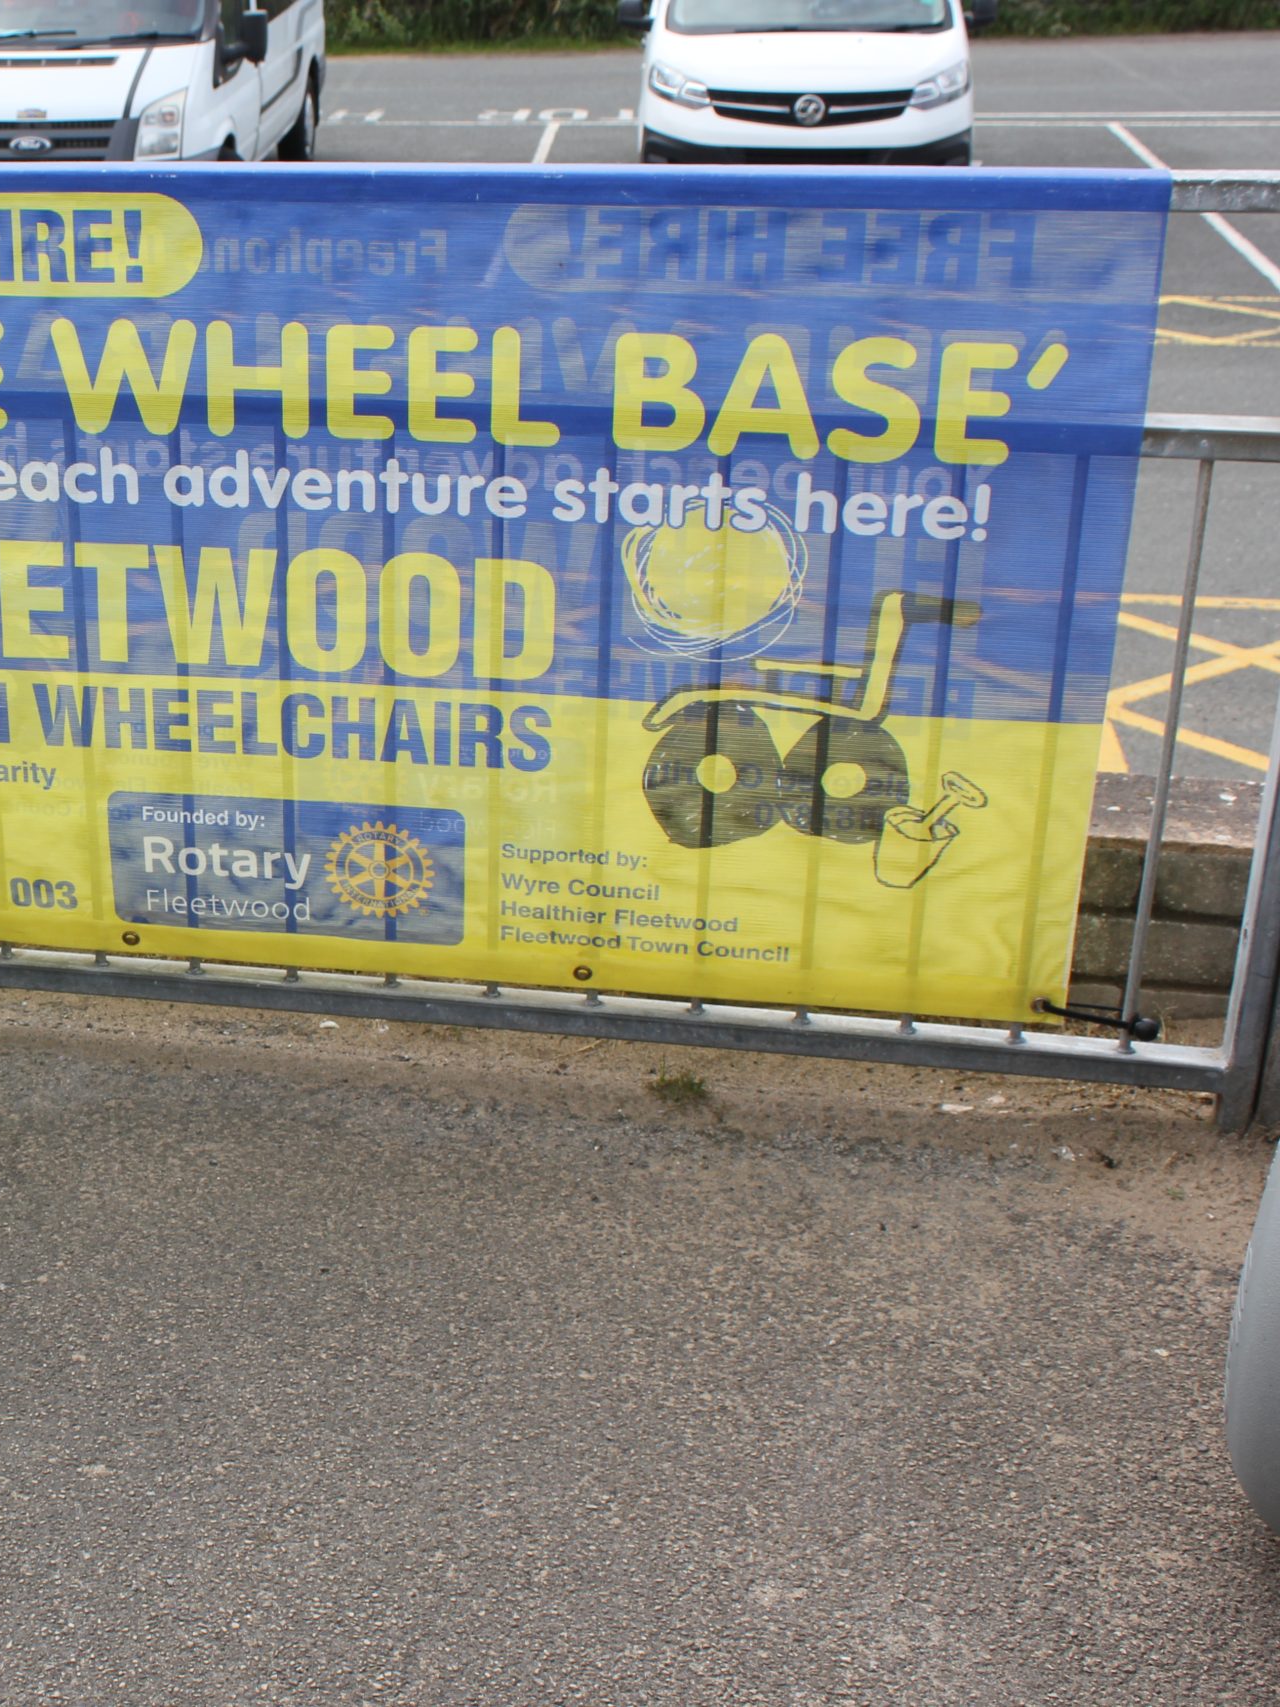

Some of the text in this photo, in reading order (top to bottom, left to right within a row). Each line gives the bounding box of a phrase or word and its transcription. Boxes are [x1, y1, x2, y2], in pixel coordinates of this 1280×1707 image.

[49, 318, 561, 448] WHEEL
[163, 449, 527, 519] adventure
[552, 466, 769, 532] starts
[794, 472, 991, 542] here!
[32, 683, 555, 773] WHEELCHAIRS
[141, 805, 266, 830] Founded by:
[356, 831, 403, 846] ROTARY
[142, 835, 312, 890] Rotary
[501, 843, 648, 870] Supported by:
[10, 877, 79, 910] 003
[501, 872, 660, 901] Wyre Council
[146, 888, 311, 922] Fleetwood
[501, 900, 738, 933] Healthier Fleetwood
[500, 925, 790, 962] Fleetwood Town Council
